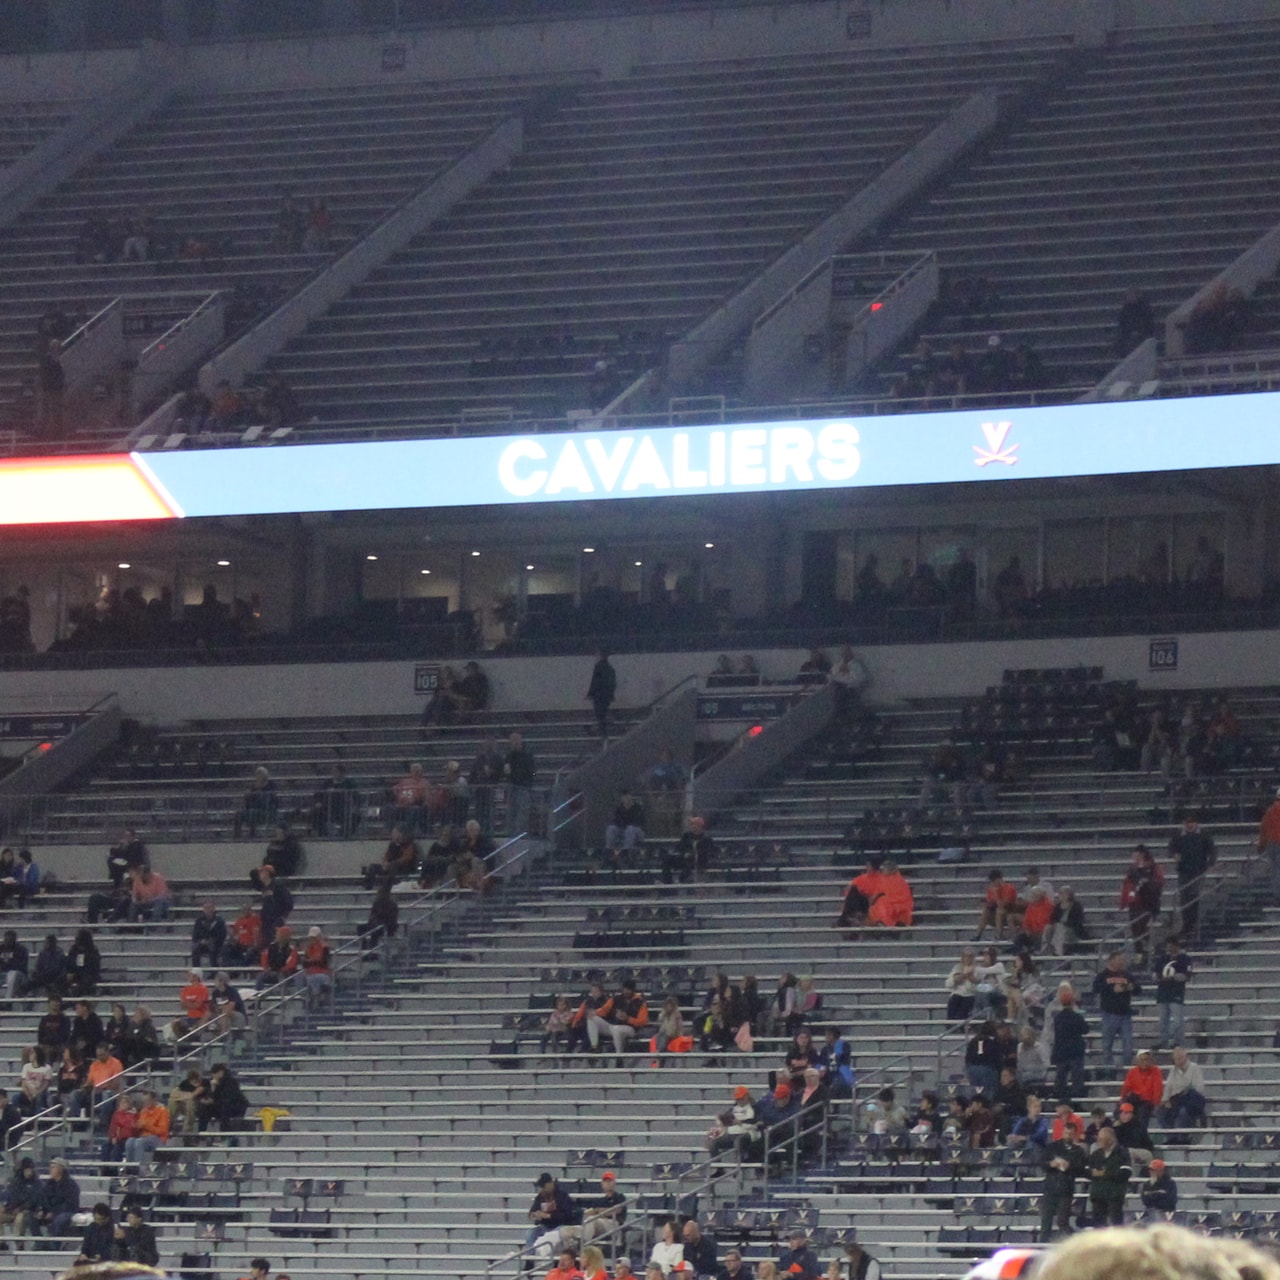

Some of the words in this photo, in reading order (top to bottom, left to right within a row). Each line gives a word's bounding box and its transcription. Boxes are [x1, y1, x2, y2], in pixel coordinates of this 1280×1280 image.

[496, 423, 862, 504] CAVALIERS
[1151, 650, 1175, 665] 106
[417, 675, 438, 689] 105
